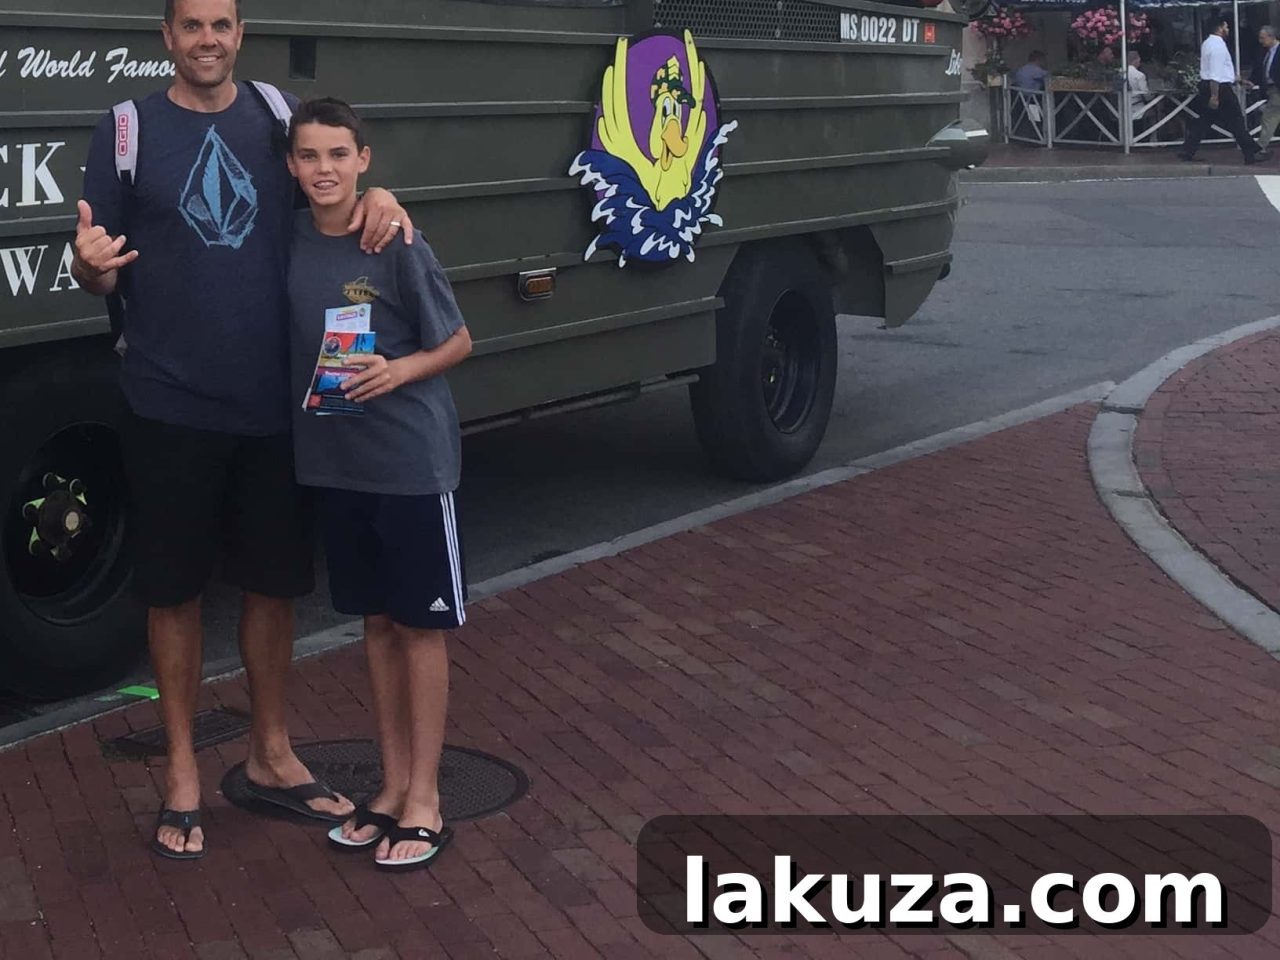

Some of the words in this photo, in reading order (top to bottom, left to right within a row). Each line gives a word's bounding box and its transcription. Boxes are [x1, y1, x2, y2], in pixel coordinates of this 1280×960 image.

[840, 13, 858, 40] MS
[861, 15, 896, 43] 0022
[902, 18, 920, 42] DT
[17, 46, 97, 79] World
